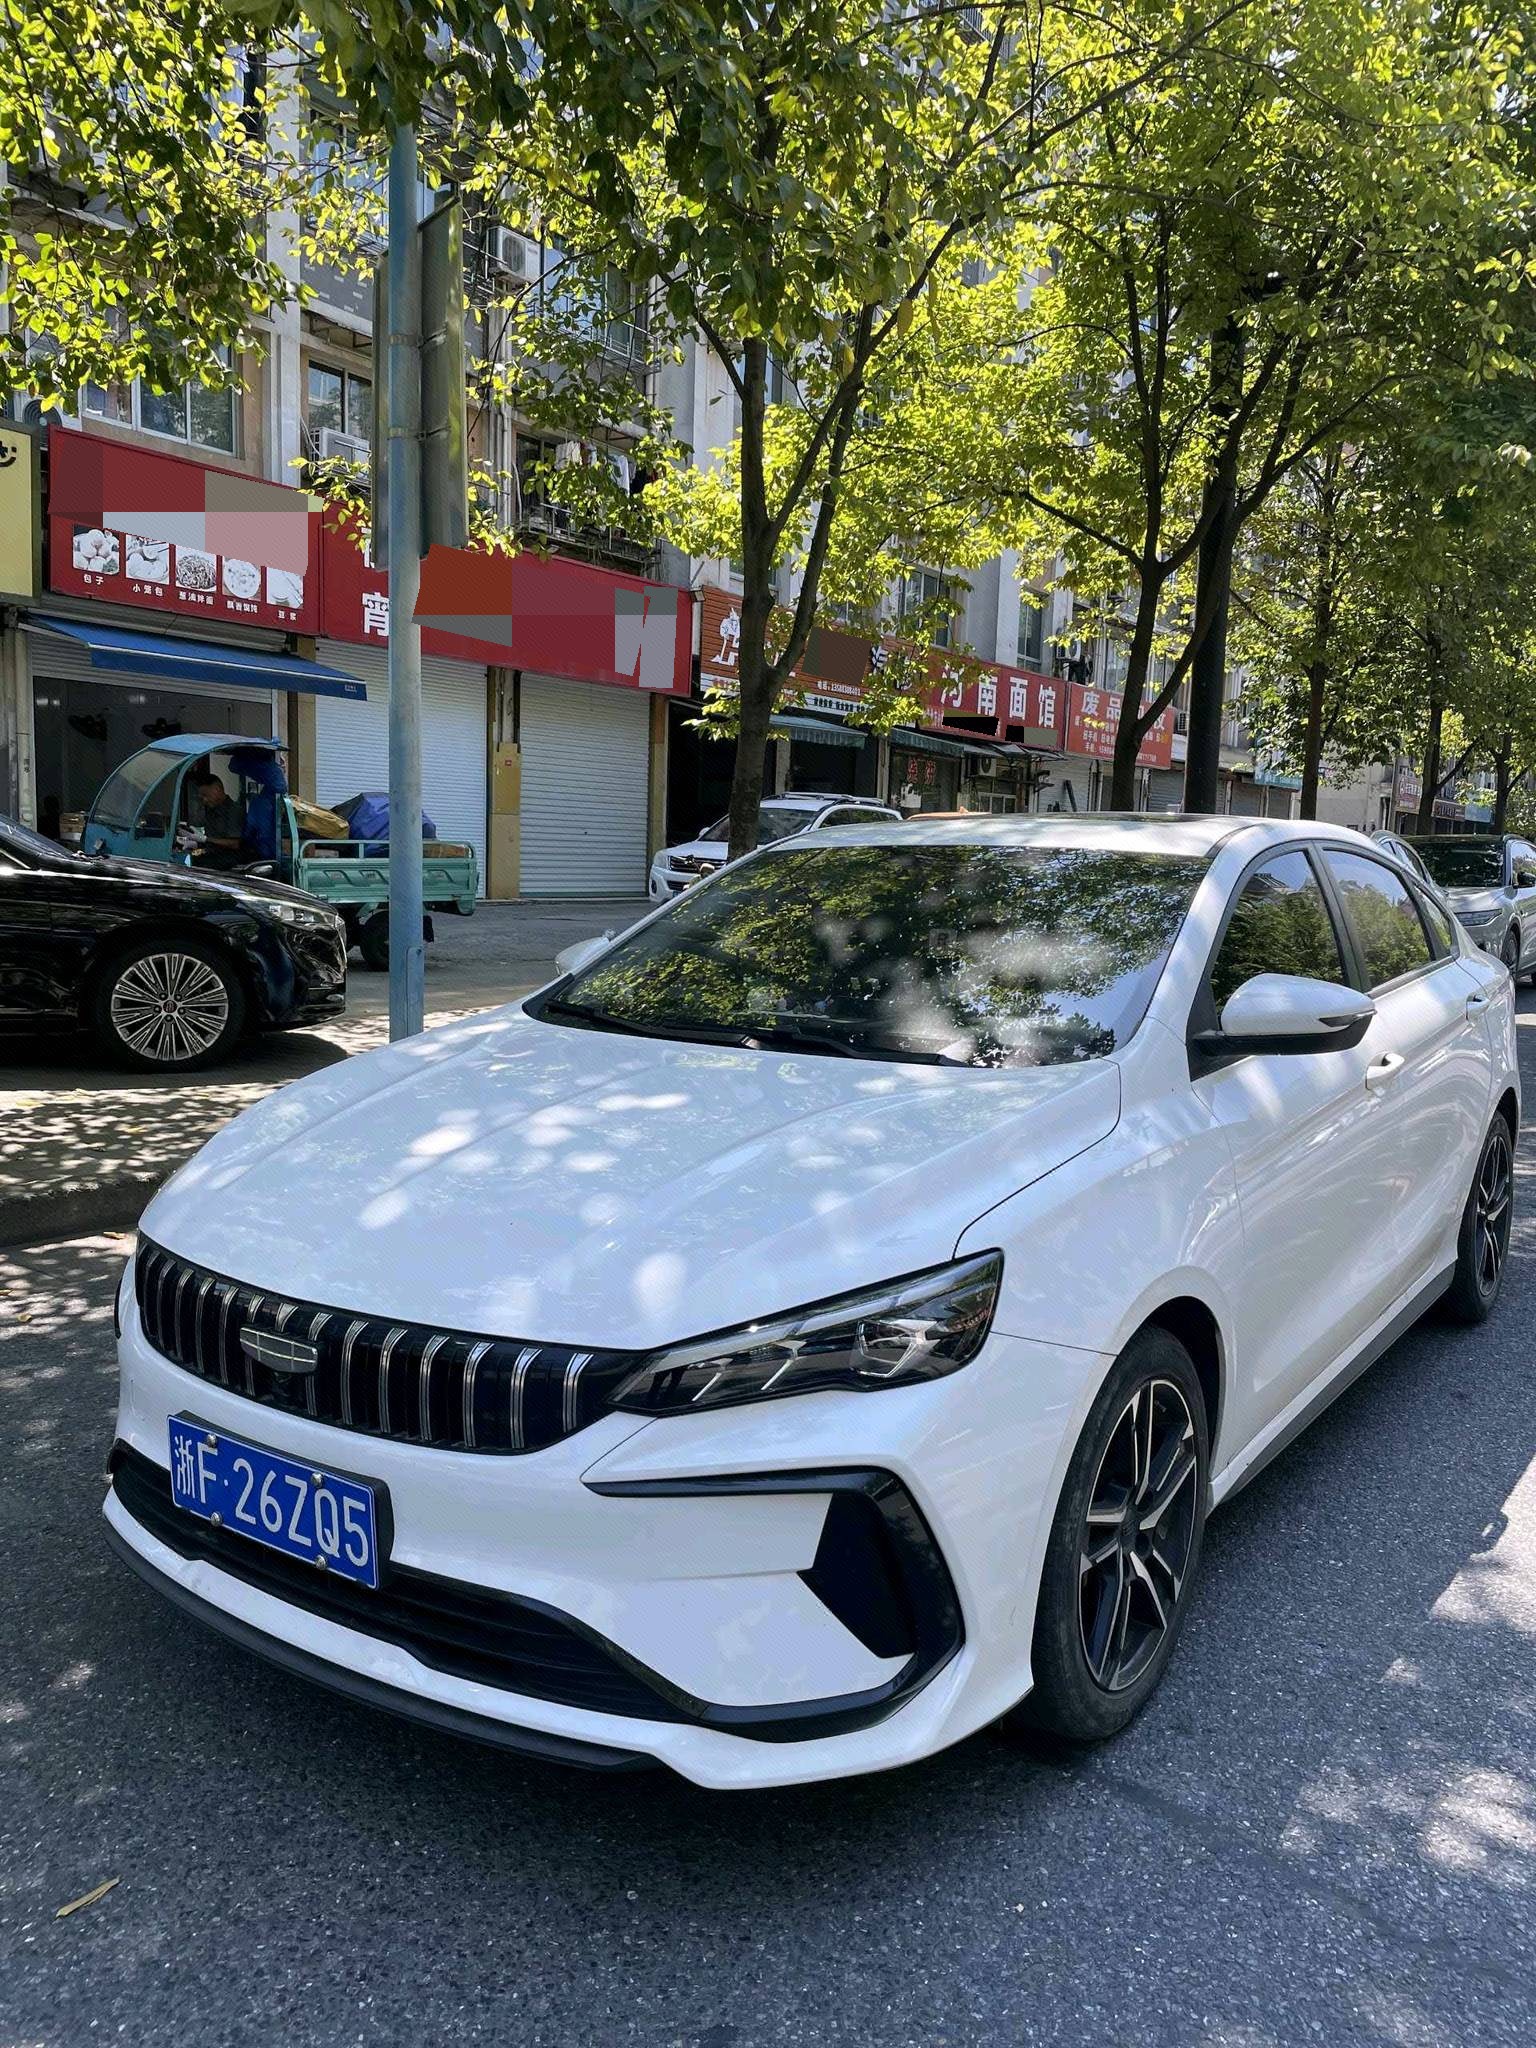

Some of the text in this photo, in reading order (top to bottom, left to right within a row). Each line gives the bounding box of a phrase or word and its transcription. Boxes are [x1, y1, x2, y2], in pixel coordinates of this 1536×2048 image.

[83, 574, 104, 585] 包子
[132, 584, 163, 597] 小笼包
[174, 1435, 369, 1567] 浙F·26ZQ5
